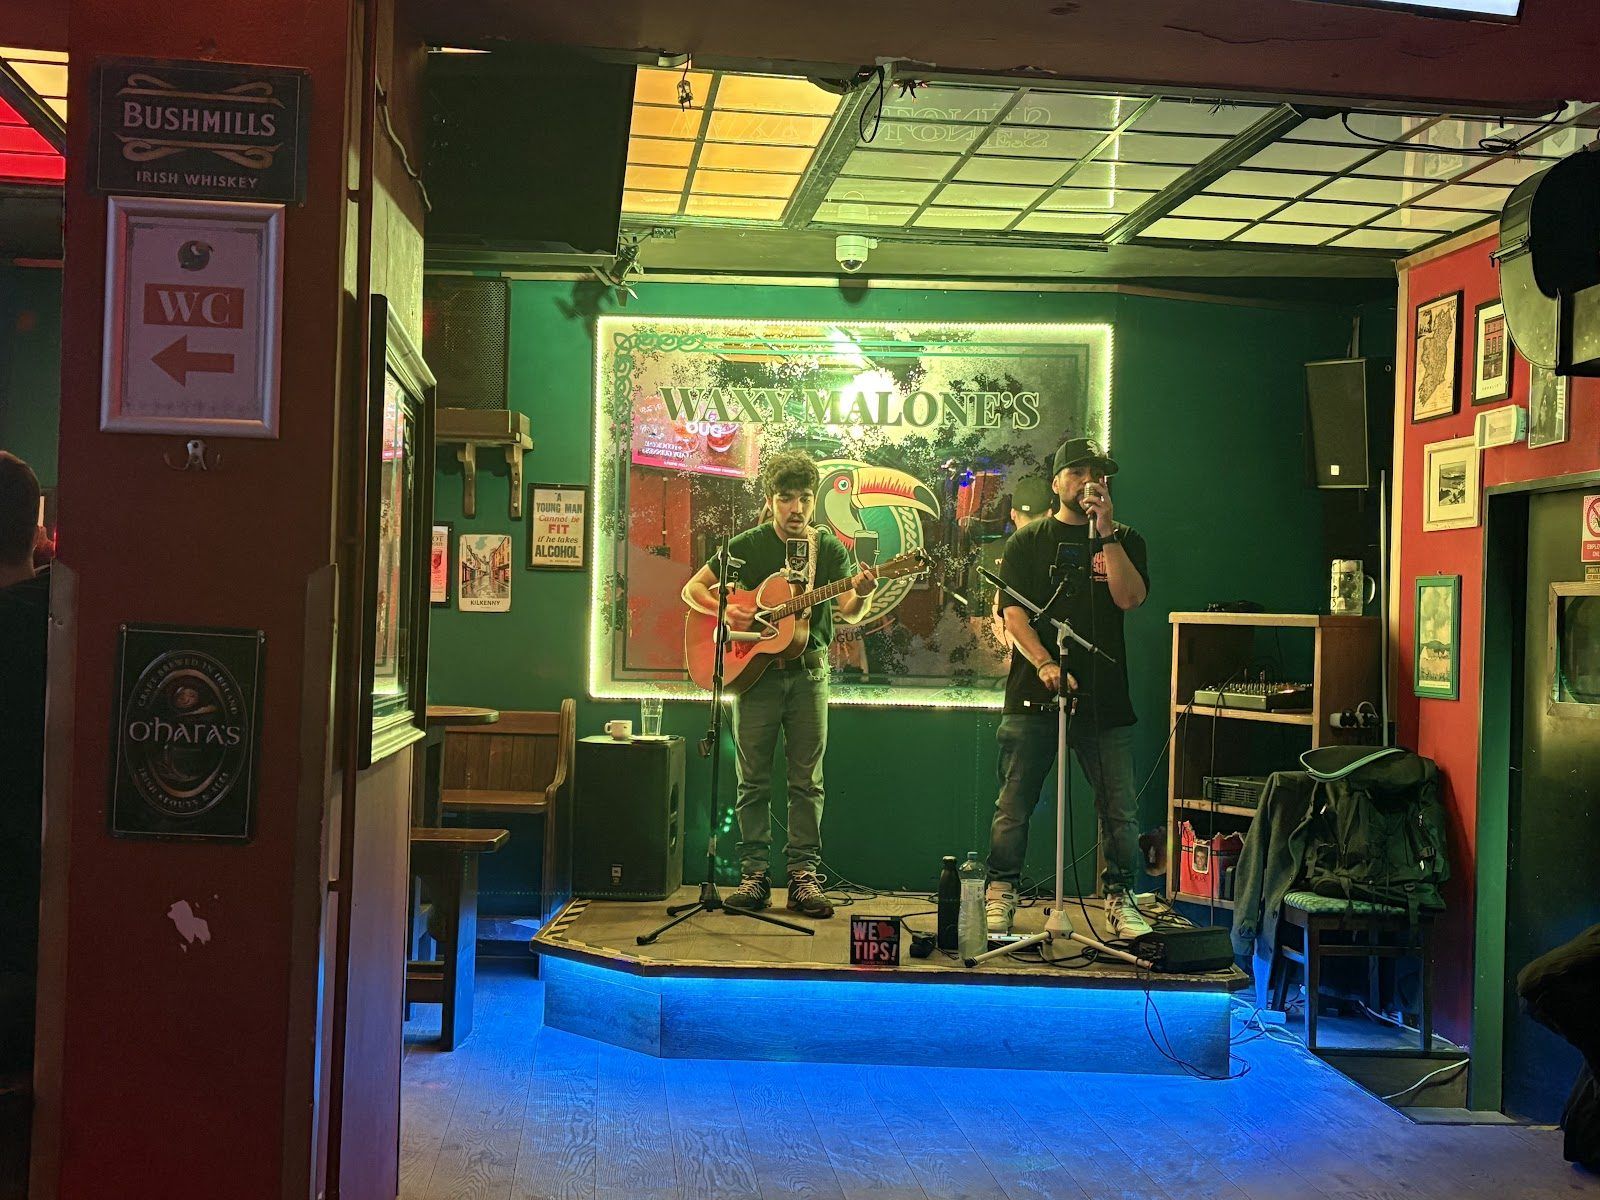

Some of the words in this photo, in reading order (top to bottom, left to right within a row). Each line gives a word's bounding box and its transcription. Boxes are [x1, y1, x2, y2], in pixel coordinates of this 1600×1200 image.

[123, 101, 276, 137] BUSHMILLS
[136, 170, 178, 185] IRISH
[184, 173, 258, 188] WHISKEY
[158, 290, 230, 325] WC
[658, 386, 793, 424] WAXY
[803, 390, 1040, 430] MALONE'S
[536, 502, 561, 514] YOUNG
[564, 503, 582, 514] MAN
[538, 514, 568, 523] Cannot
[570, 514, 580, 523] be
[548, 524, 570, 535] FIT
[537, 535, 545, 543] if
[545, 535, 556, 544] he
[557, 536, 579, 544] takes
[853, 921, 878, 941] WE
[853, 941, 898, 961] TIPS!
